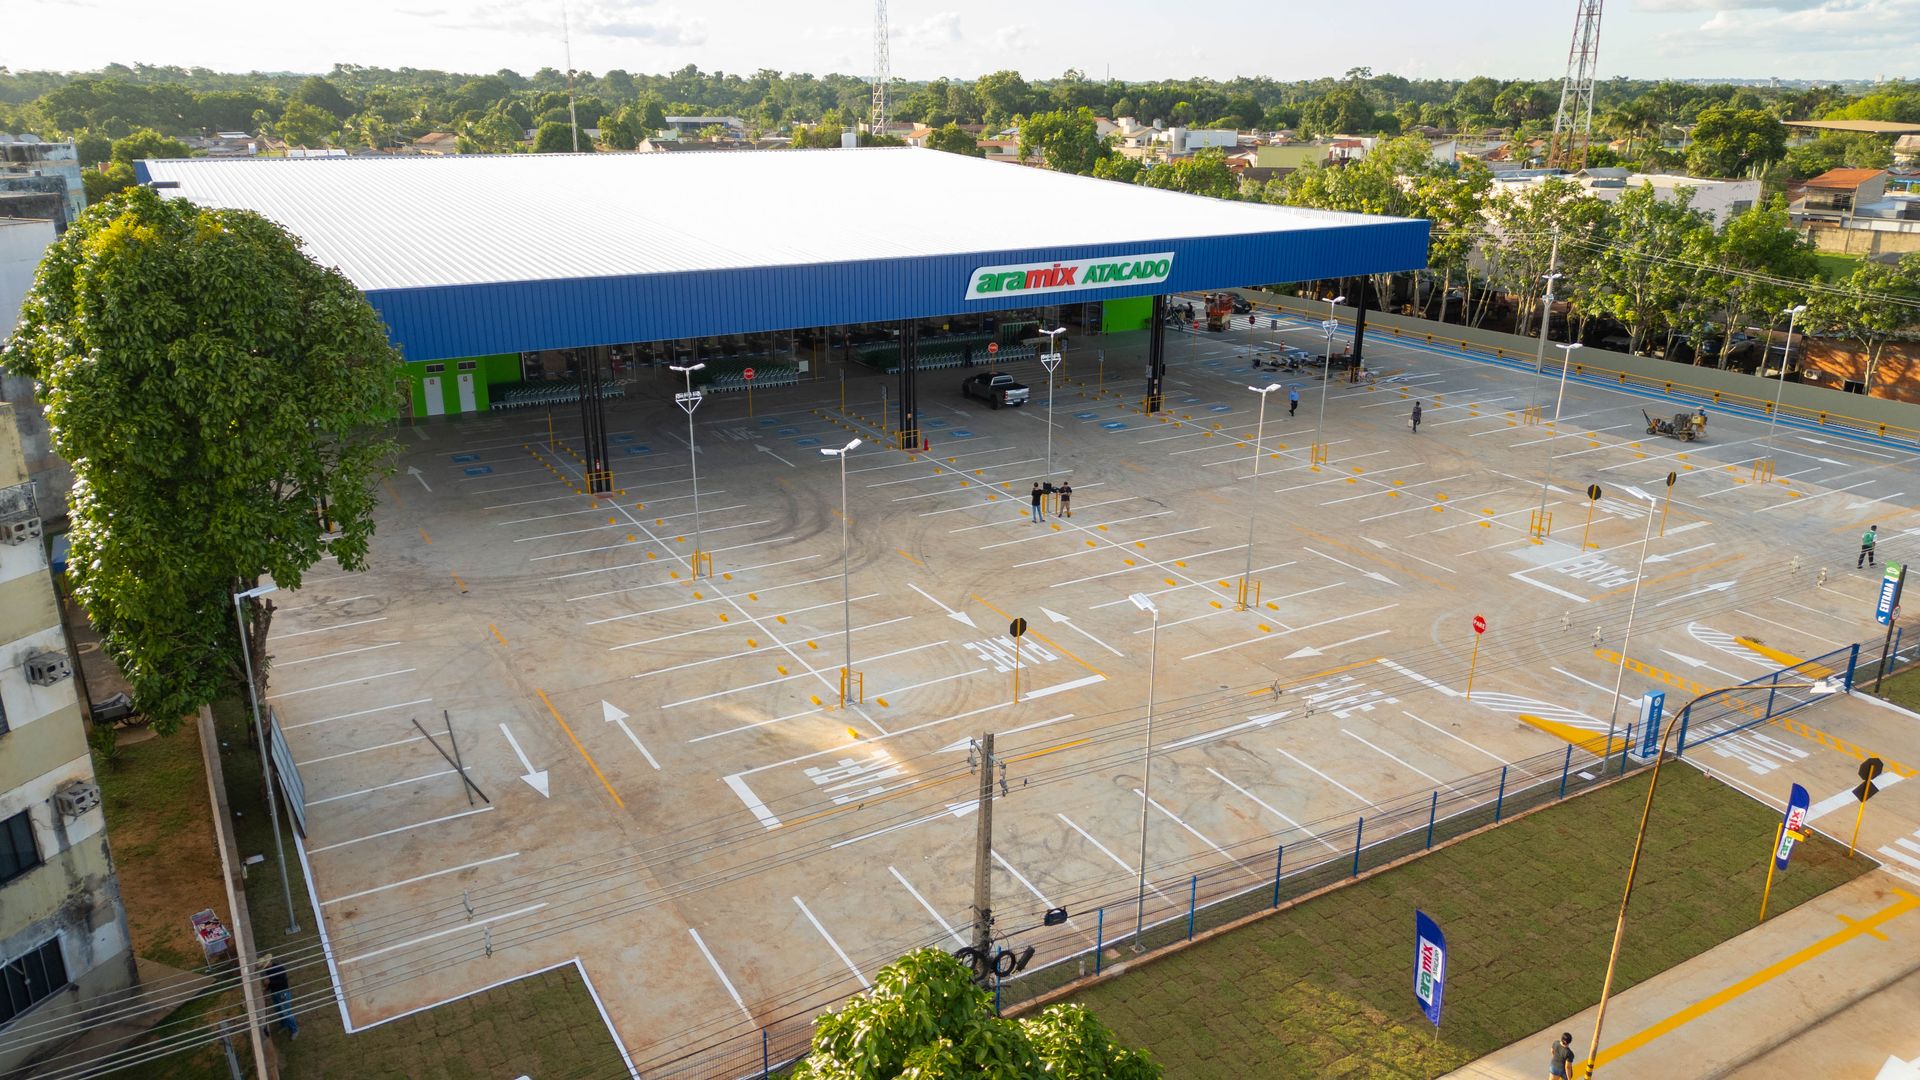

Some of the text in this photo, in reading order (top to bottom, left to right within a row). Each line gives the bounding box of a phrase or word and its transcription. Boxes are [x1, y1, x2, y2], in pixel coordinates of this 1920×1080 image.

[975, 259, 1170, 294] aramix ATACADO
[1554, 554, 1649, 589] PARE
[1879, 582, 1895, 613] ENTRADA
[962, 635, 1062, 673] PARE
[1287, 674, 1400, 720] PARE
[803, 748, 921, 806] PARE
[1419, 943, 1434, 999] aramix
